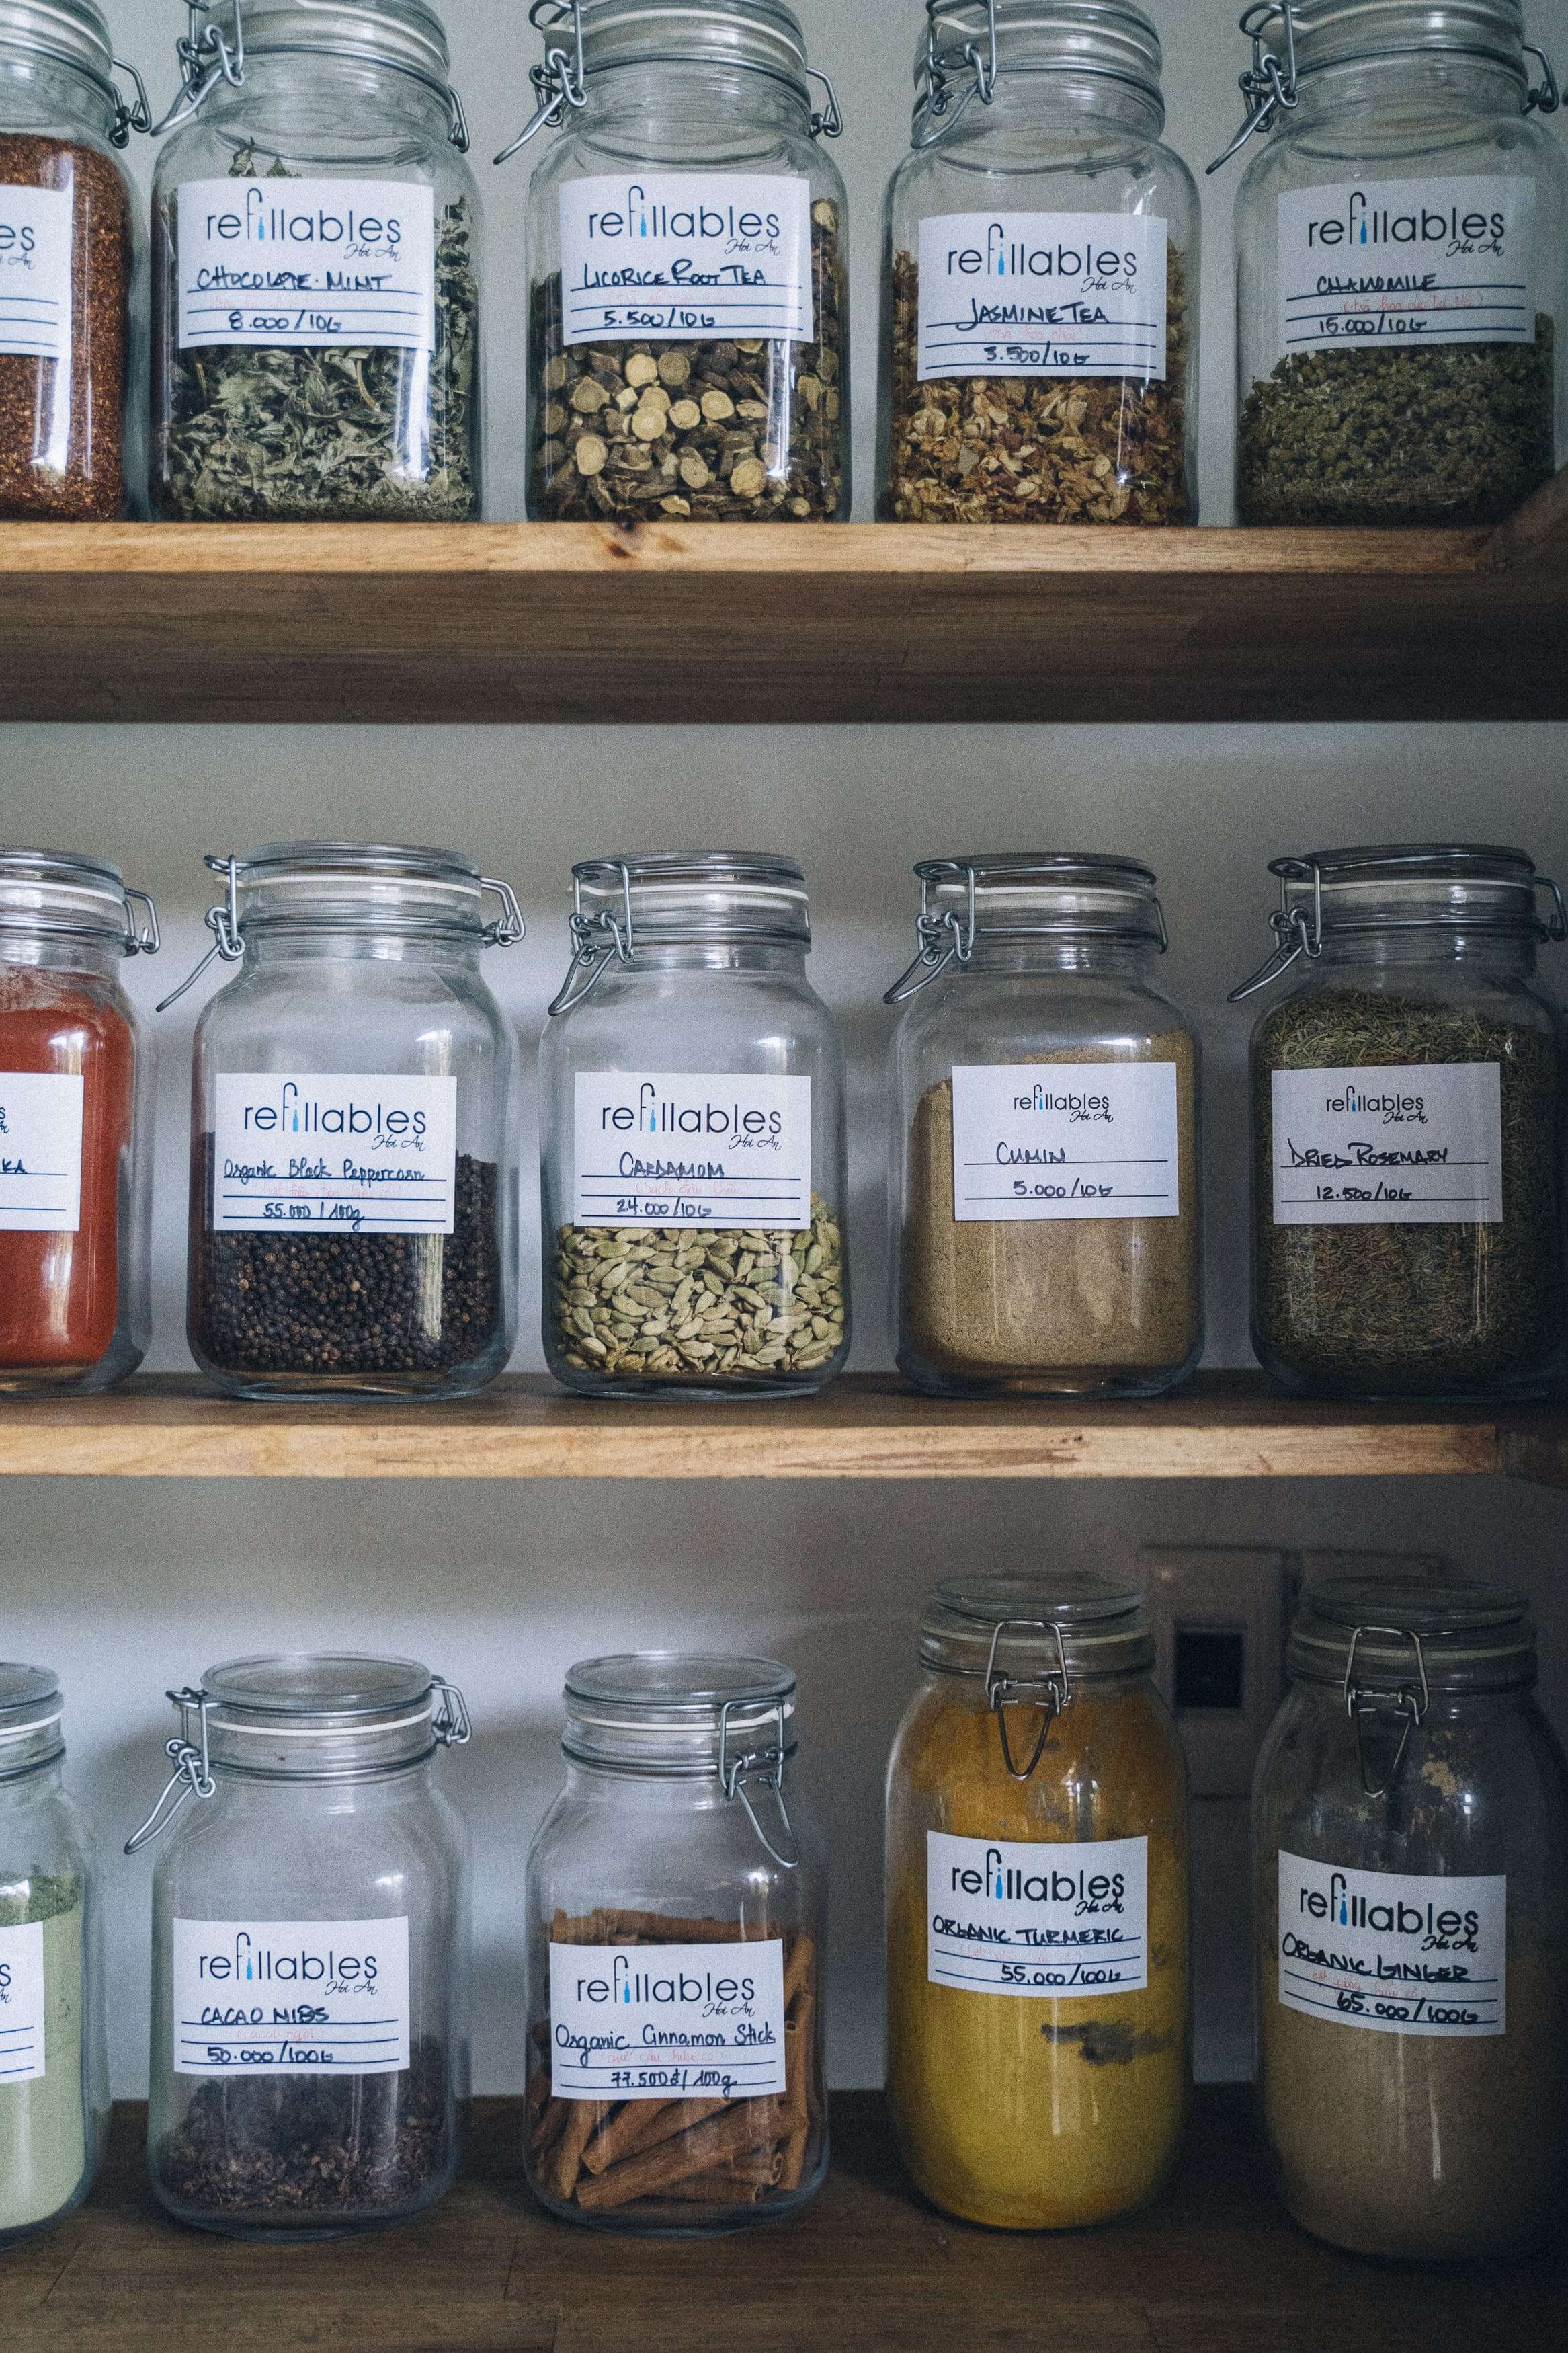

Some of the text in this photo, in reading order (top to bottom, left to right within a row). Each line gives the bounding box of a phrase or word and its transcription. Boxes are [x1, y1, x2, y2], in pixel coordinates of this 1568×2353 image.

[208, 188, 401, 243] refillables
[589, 186, 780, 238] refillables
[1309, 192, 1505, 247] refillables
[725, 239, 780, 256] Hoi An
[948, 223, 1137, 276] refillables
[1446, 239, 1504, 257] Hoi An
[197, 266, 392, 290] CHOCOLATE MINT
[585, 259, 766, 288] LICORICE ROOT TEA
[245, 1082, 426, 1134] refillables
[602, 1082, 782, 1133] refillables
[1014, 1084, 1109, 1111] refillables
[1326, 1086, 1423, 1112] refillables
[371, 1135, 426, 1151] Hoi An
[757, 1135, 781, 1151] An
[997, 1142, 1065, 1164] CUMIN
[1287, 1138, 1448, 1168] DRIED ROSEMARY
[224, 1158, 277, 1184] Organic
[289, 1158, 331, 1178] Black
[619, 1152, 725, 1180] CARDAMOM
[1317, 1181, 1413, 1201] 12.500/10G
[952, 1848, 1124, 1901] refillables
[1301, 1872, 1479, 1936] refillables
[933, 1915, 1124, 1944] ORGANIC TURMERIC
[200, 1932, 377, 1980] refillables
[1282, 1932, 1372, 1976] ORGANIC
[325, 1979, 378, 1995] Hoi An
[577, 1956, 755, 2003] refillables
[202, 2005, 329, 2024] CACAO NIBS
[731, 2001, 755, 2018] An
[556, 2024, 630, 2067] Organic
[643, 2024, 725, 2046] Cinnamon
[735, 2022, 776, 2045] Stick
